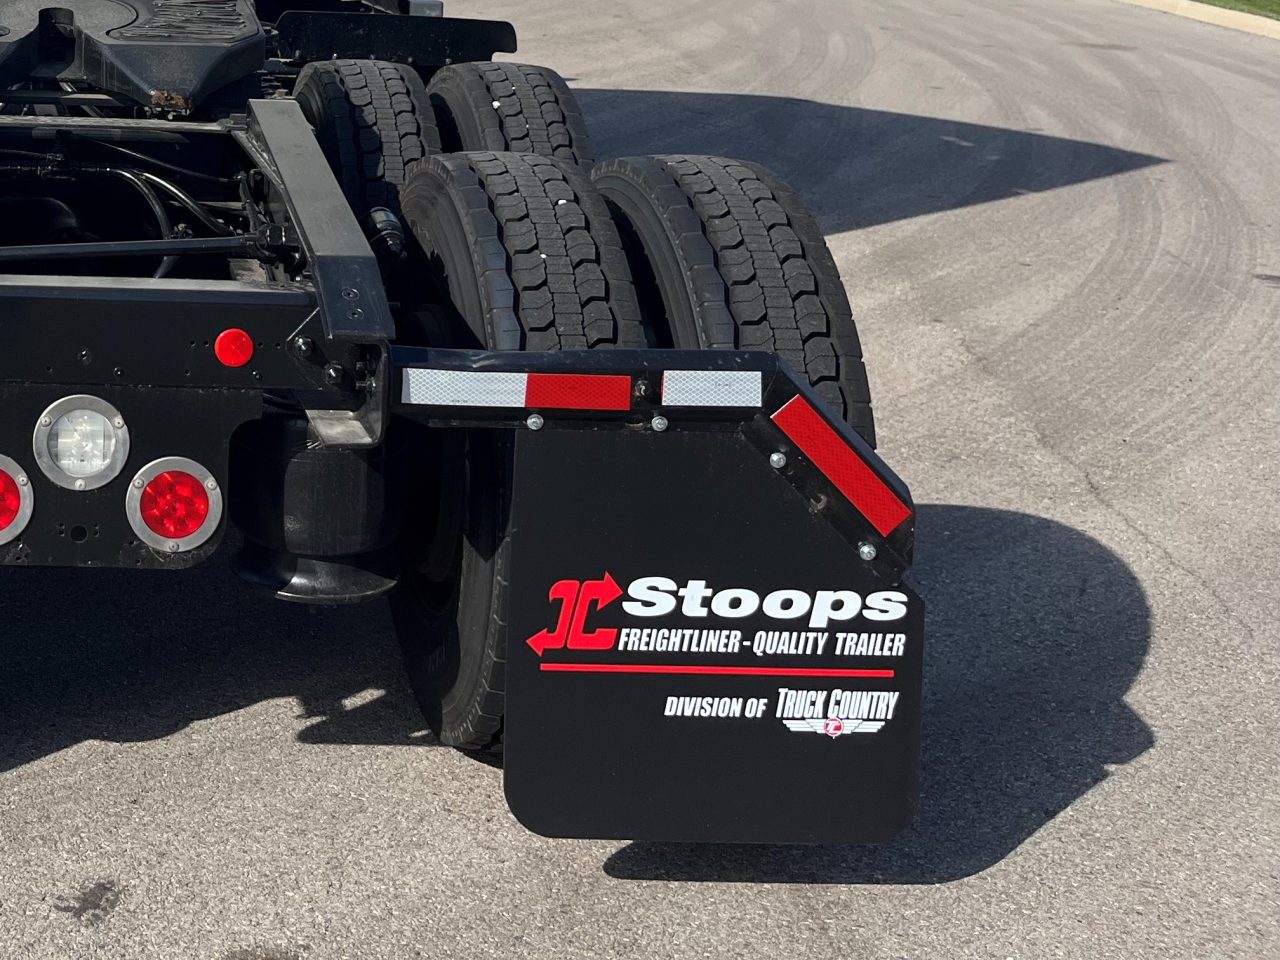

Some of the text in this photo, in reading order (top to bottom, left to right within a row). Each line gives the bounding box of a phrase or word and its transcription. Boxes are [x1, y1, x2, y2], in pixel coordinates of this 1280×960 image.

[621, 576, 908, 629] Stoops
[834, 632, 907, 656] TRAILER
[664, 687, 900, 720] DIVISION OF TRUCK COUNTRY
